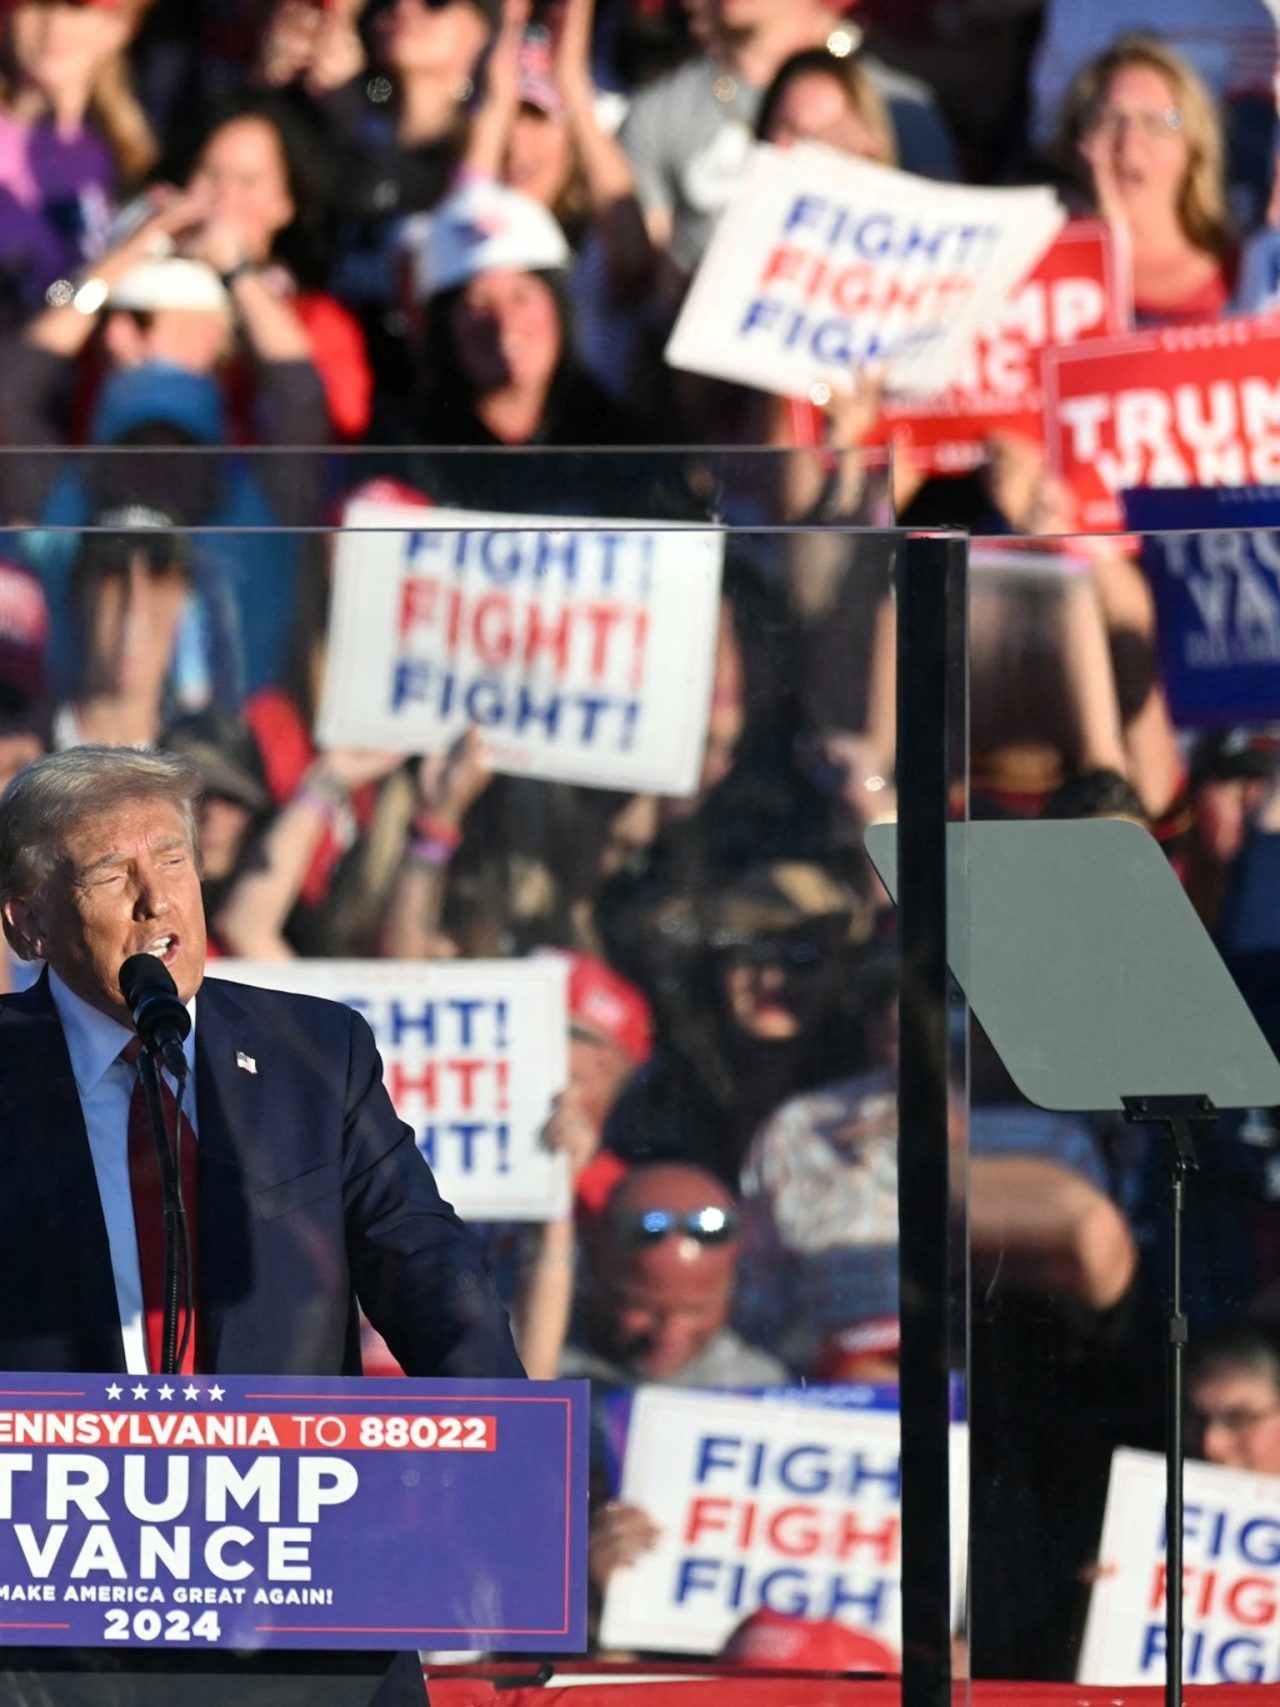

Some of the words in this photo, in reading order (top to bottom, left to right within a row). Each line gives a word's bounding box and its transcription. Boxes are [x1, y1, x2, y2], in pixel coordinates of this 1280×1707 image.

[1058, 377, 1280, 461] TRUM
[1094, 438, 1280, 488] VANC
[402, 531, 655, 594] FIGHT!
[395, 577, 651, 689] FIGHT!
[387, 659, 641, 753] FIGHT!
[291, 1415, 347, 1447] TO
[359, 1417, 488, 1448] 88022
[695, 1435, 901, 1498] FIGH
[13, 1524, 312, 1581] VANCE
[683, 1498, 900, 1566] FIGH
[1158, 1504, 1280, 1566] FIG
[64, 1585, 166, 1603] AMERICA
[173, 1587, 246, 1604] GREAT
[253, 1588, 334, 1605] AGAIN!
[673, 1557, 892, 1623] FIGH
[1150, 1562, 1278, 1627] FIG
[103, 1608, 221, 1642] 2024
[1140, 1623, 1270, 1683] FIG
